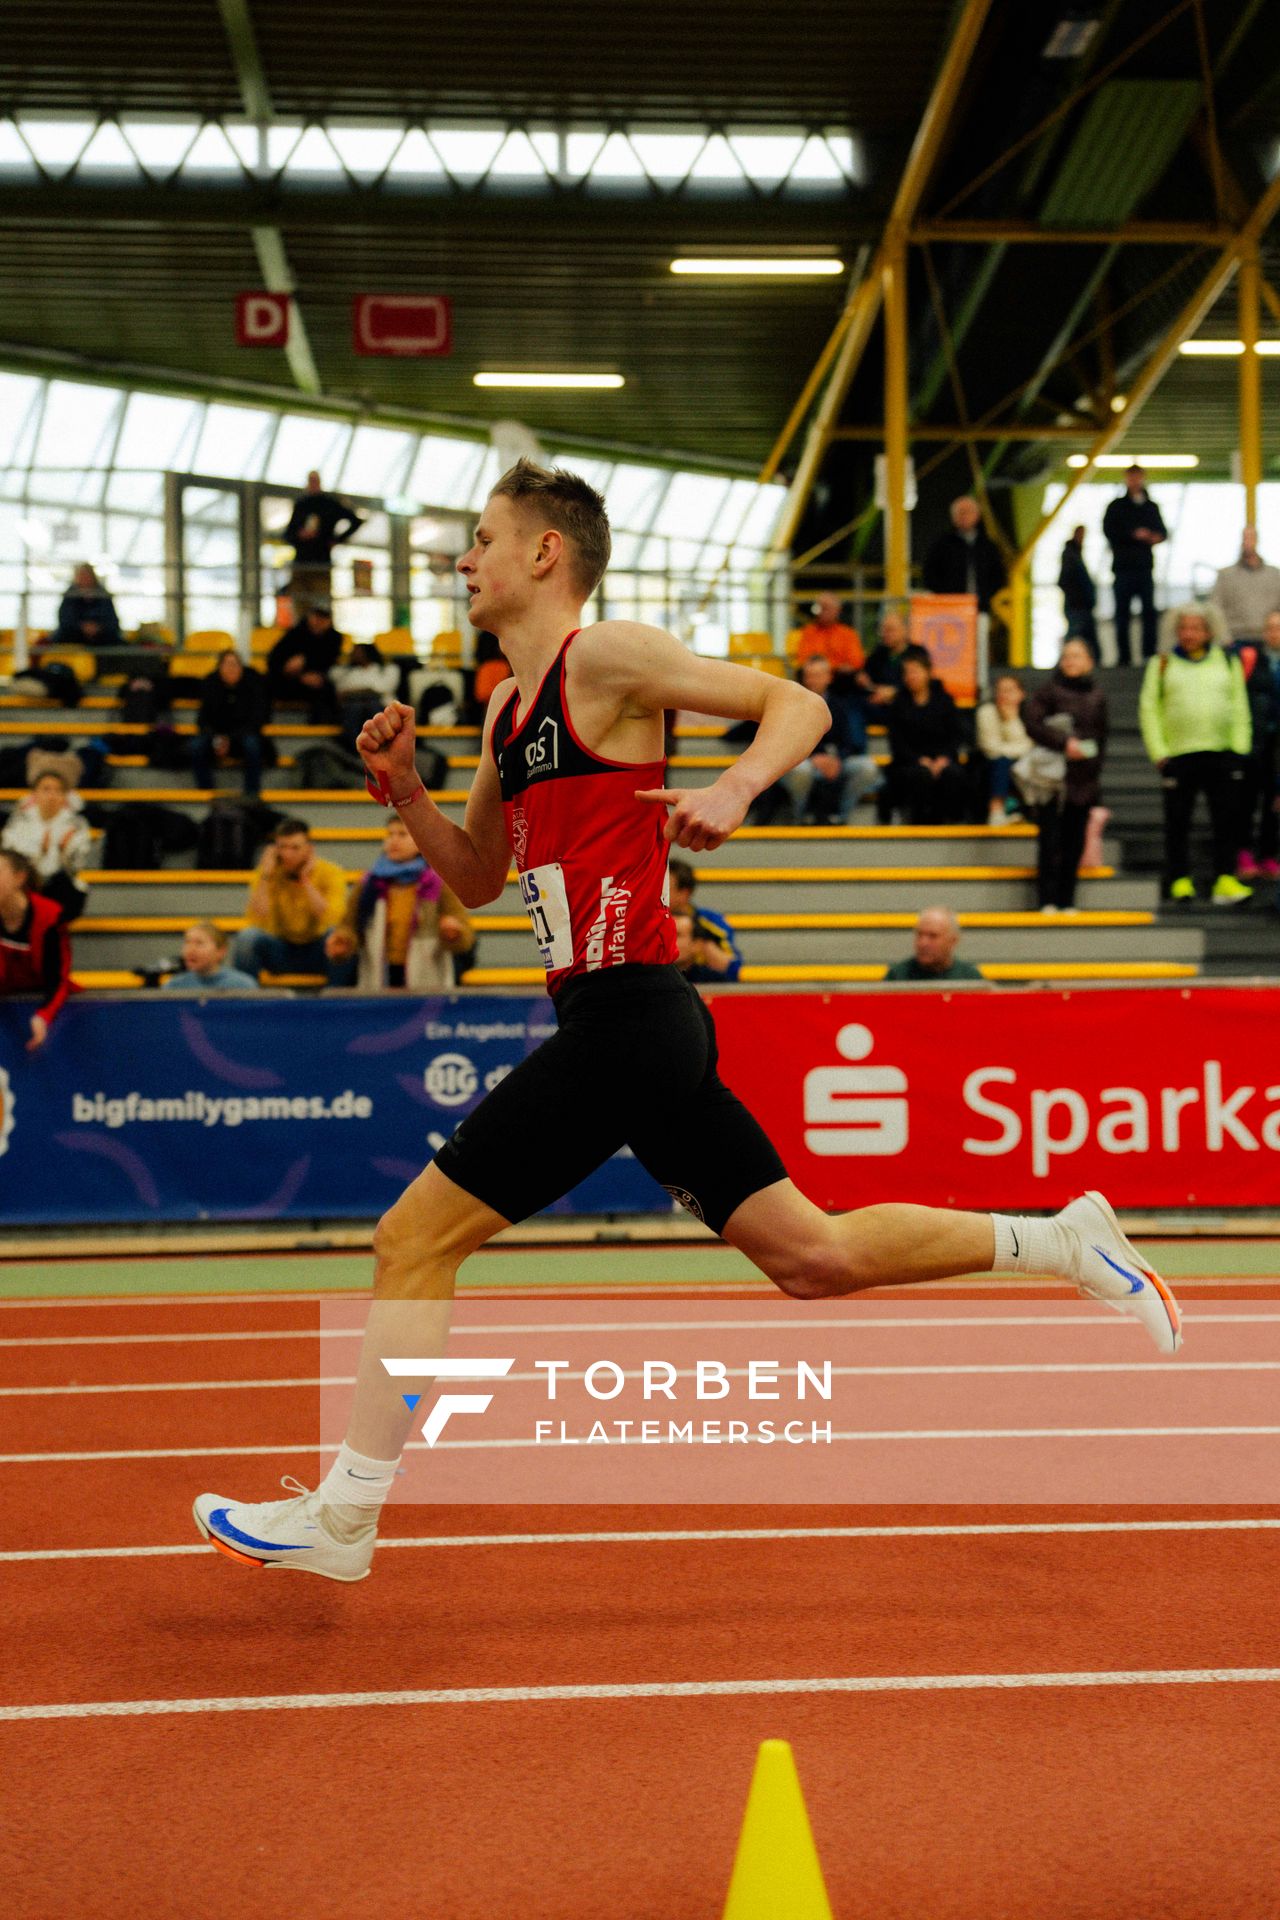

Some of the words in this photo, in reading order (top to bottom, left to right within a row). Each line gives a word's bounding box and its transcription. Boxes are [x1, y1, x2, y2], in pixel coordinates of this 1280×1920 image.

[244, 298, 282, 338] D
[608, 880, 632, 966] ufanaly
[72, 1089, 373, 1127] bigfamilygames.de
